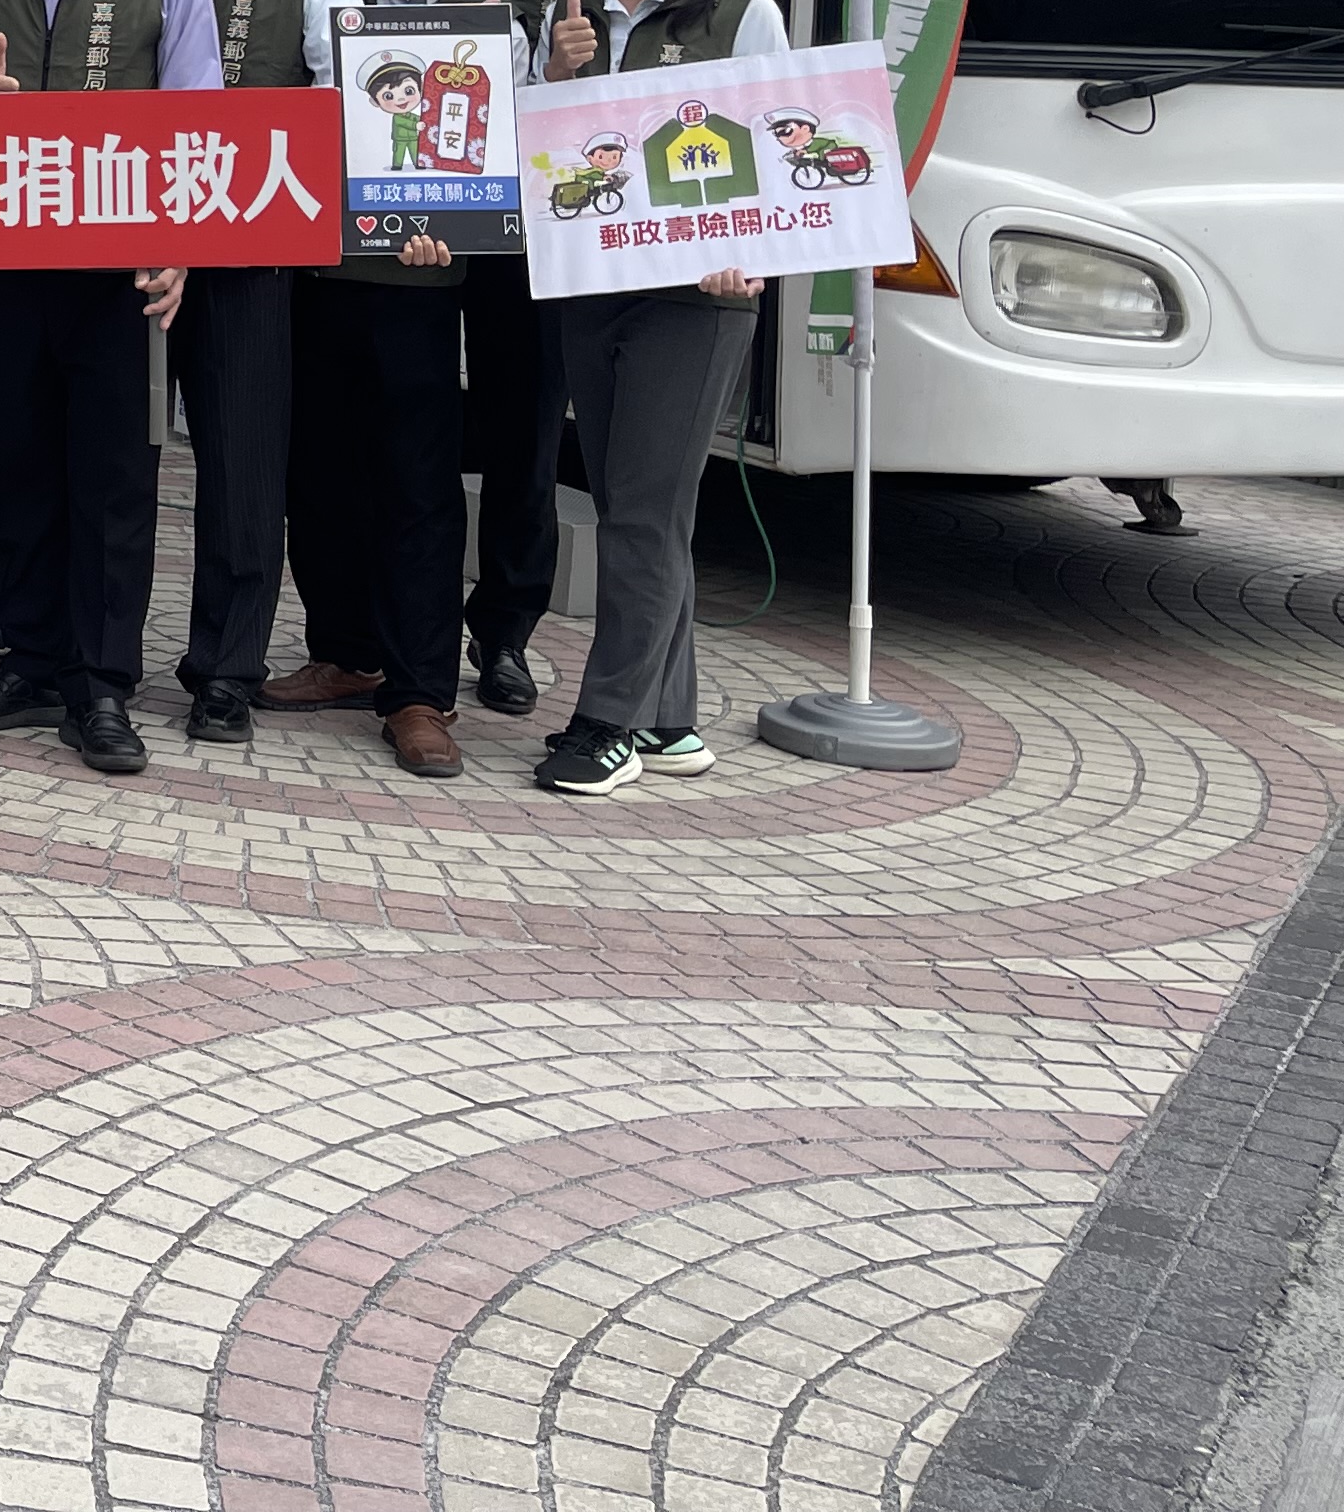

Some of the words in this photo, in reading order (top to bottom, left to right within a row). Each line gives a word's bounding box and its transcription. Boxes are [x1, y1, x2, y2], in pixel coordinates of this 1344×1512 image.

[83, 2, 115, 91] 嘉義郵局
[443, 102, 463, 150] 平安
[363, 182, 505, 203] 郵政壽險關心您
[599, 201, 834, 251] 郵政壽險關心您
